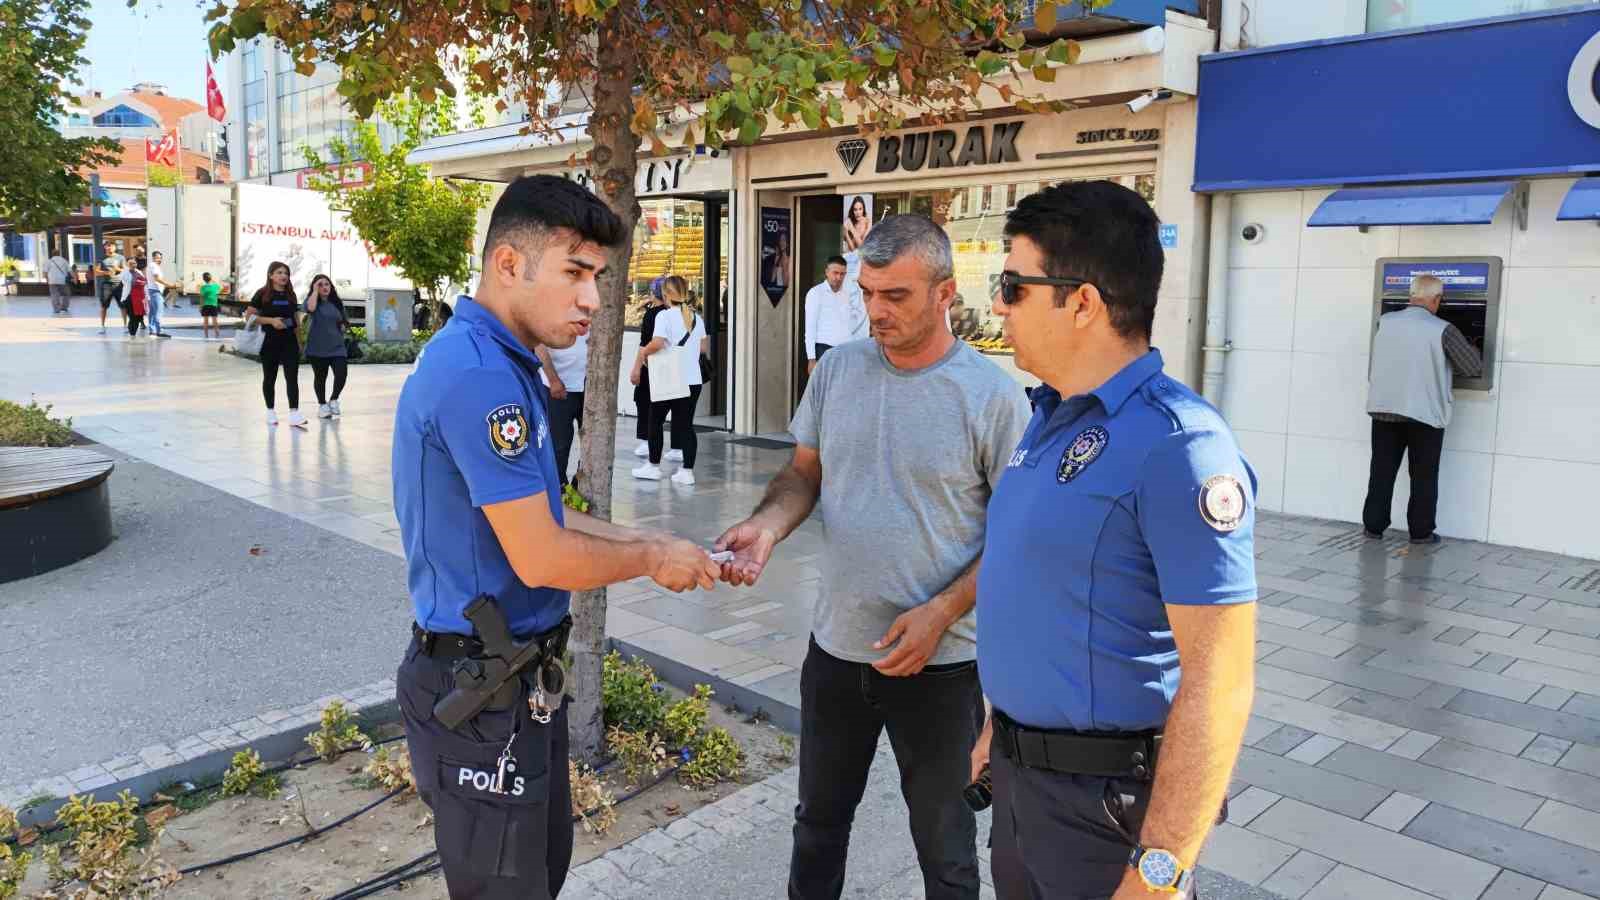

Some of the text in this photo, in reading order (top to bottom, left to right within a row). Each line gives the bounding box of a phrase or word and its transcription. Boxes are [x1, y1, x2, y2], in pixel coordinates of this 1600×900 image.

[875, 121, 1024, 173] BURAK
[1076, 128, 1126, 144] SINCE
[458, 767, 525, 796] POLS
